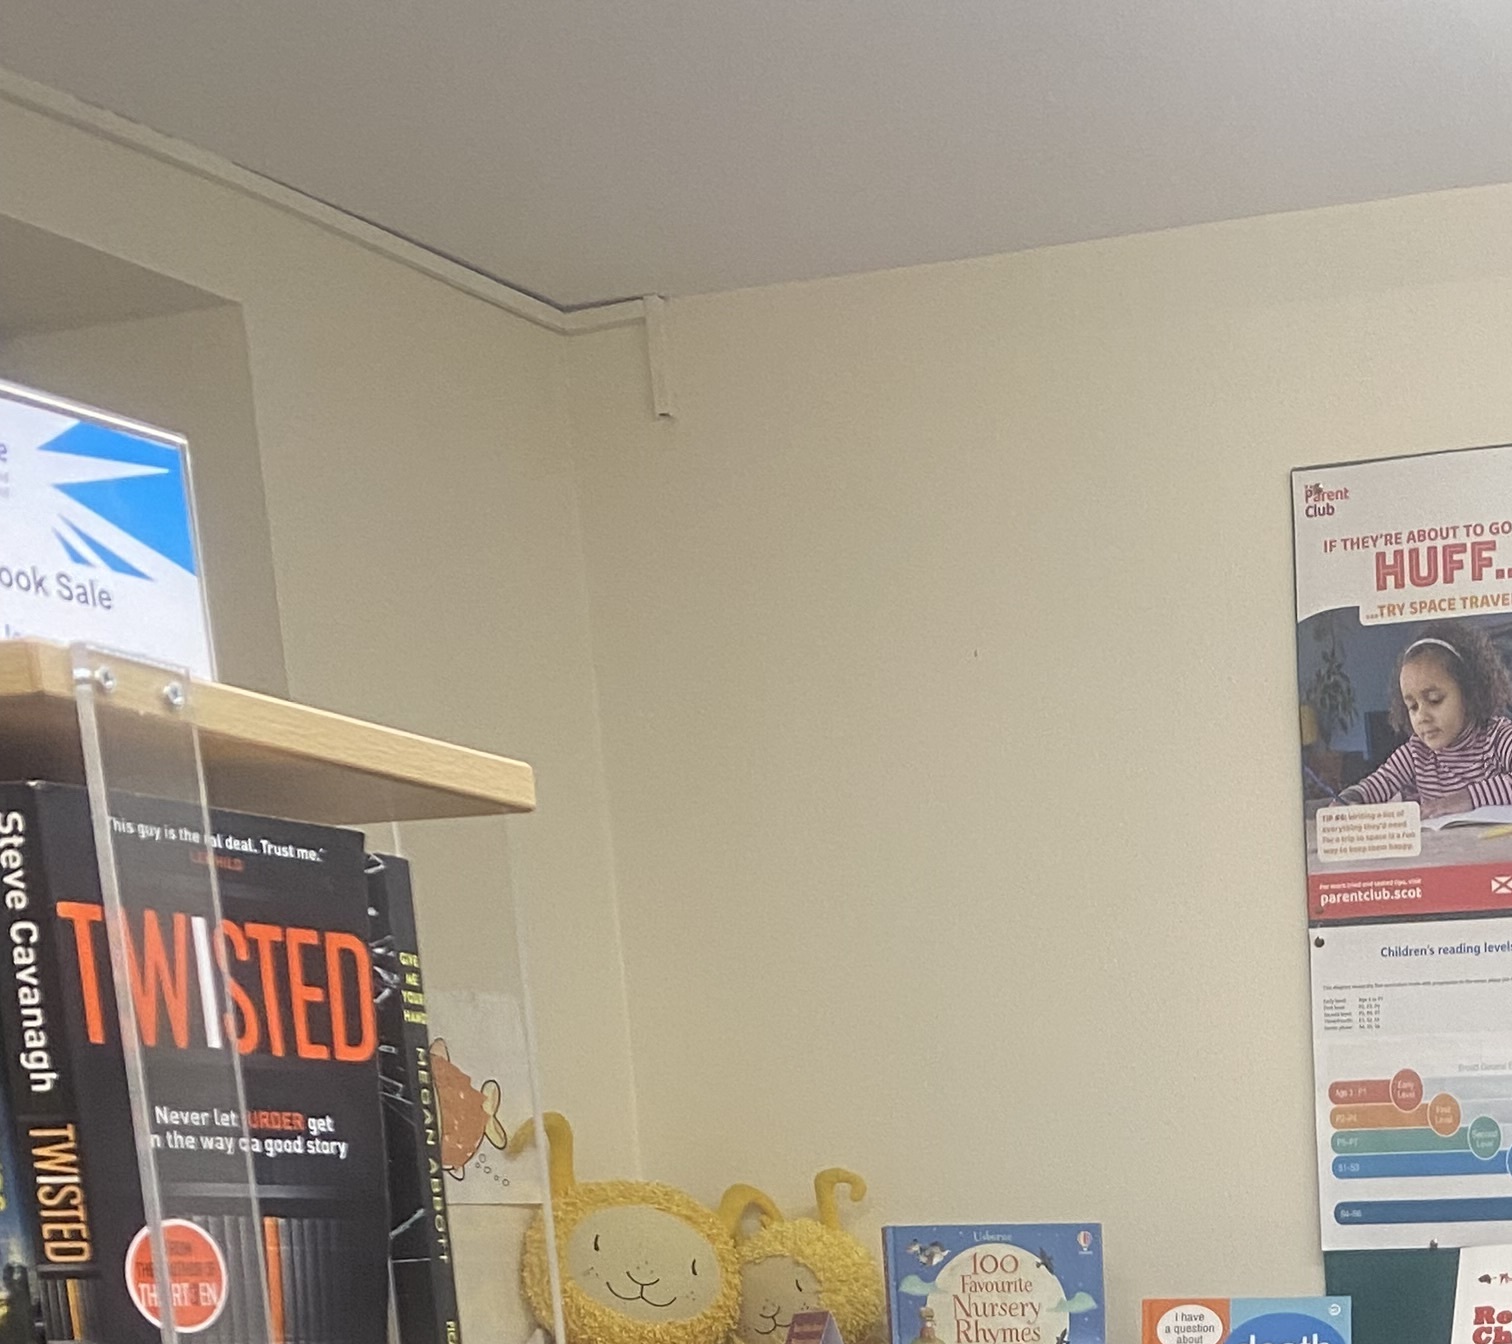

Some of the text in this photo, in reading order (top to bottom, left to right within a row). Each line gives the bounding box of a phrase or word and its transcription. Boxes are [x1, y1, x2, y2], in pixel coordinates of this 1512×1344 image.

[1304, 486, 1349, 503] Parent
[1305, 503, 1335, 517] Club
[1323, 539, 1337, 553] IF
[1341, 531, 1402, 552] THEY'RE
[1407, 526, 1459, 545] ABOUT
[1464, 524, 1485, 540] TO
[1489, 521, 1512, 536] GO
[56, 573, 113, 610] Sale
[1366, 603, 1406, 619] ...TRY
[1410, 599, 1455, 616] SPACE
[1320, 887, 1421, 907] parentclub.scot
[0, 812, 59, 1092] Steve Cavanagh
[1380, 945, 1435, 958] Children's
[1439, 943, 1481, 956] reading
[56, 900, 375, 1064] TWISTED
[28, 1125, 90, 1264] TWISTED
[971, 1253, 1019, 1274] 100
[960, 1275, 1033, 1294] Favourite
[952, 1295, 1041, 1323] Nursery
